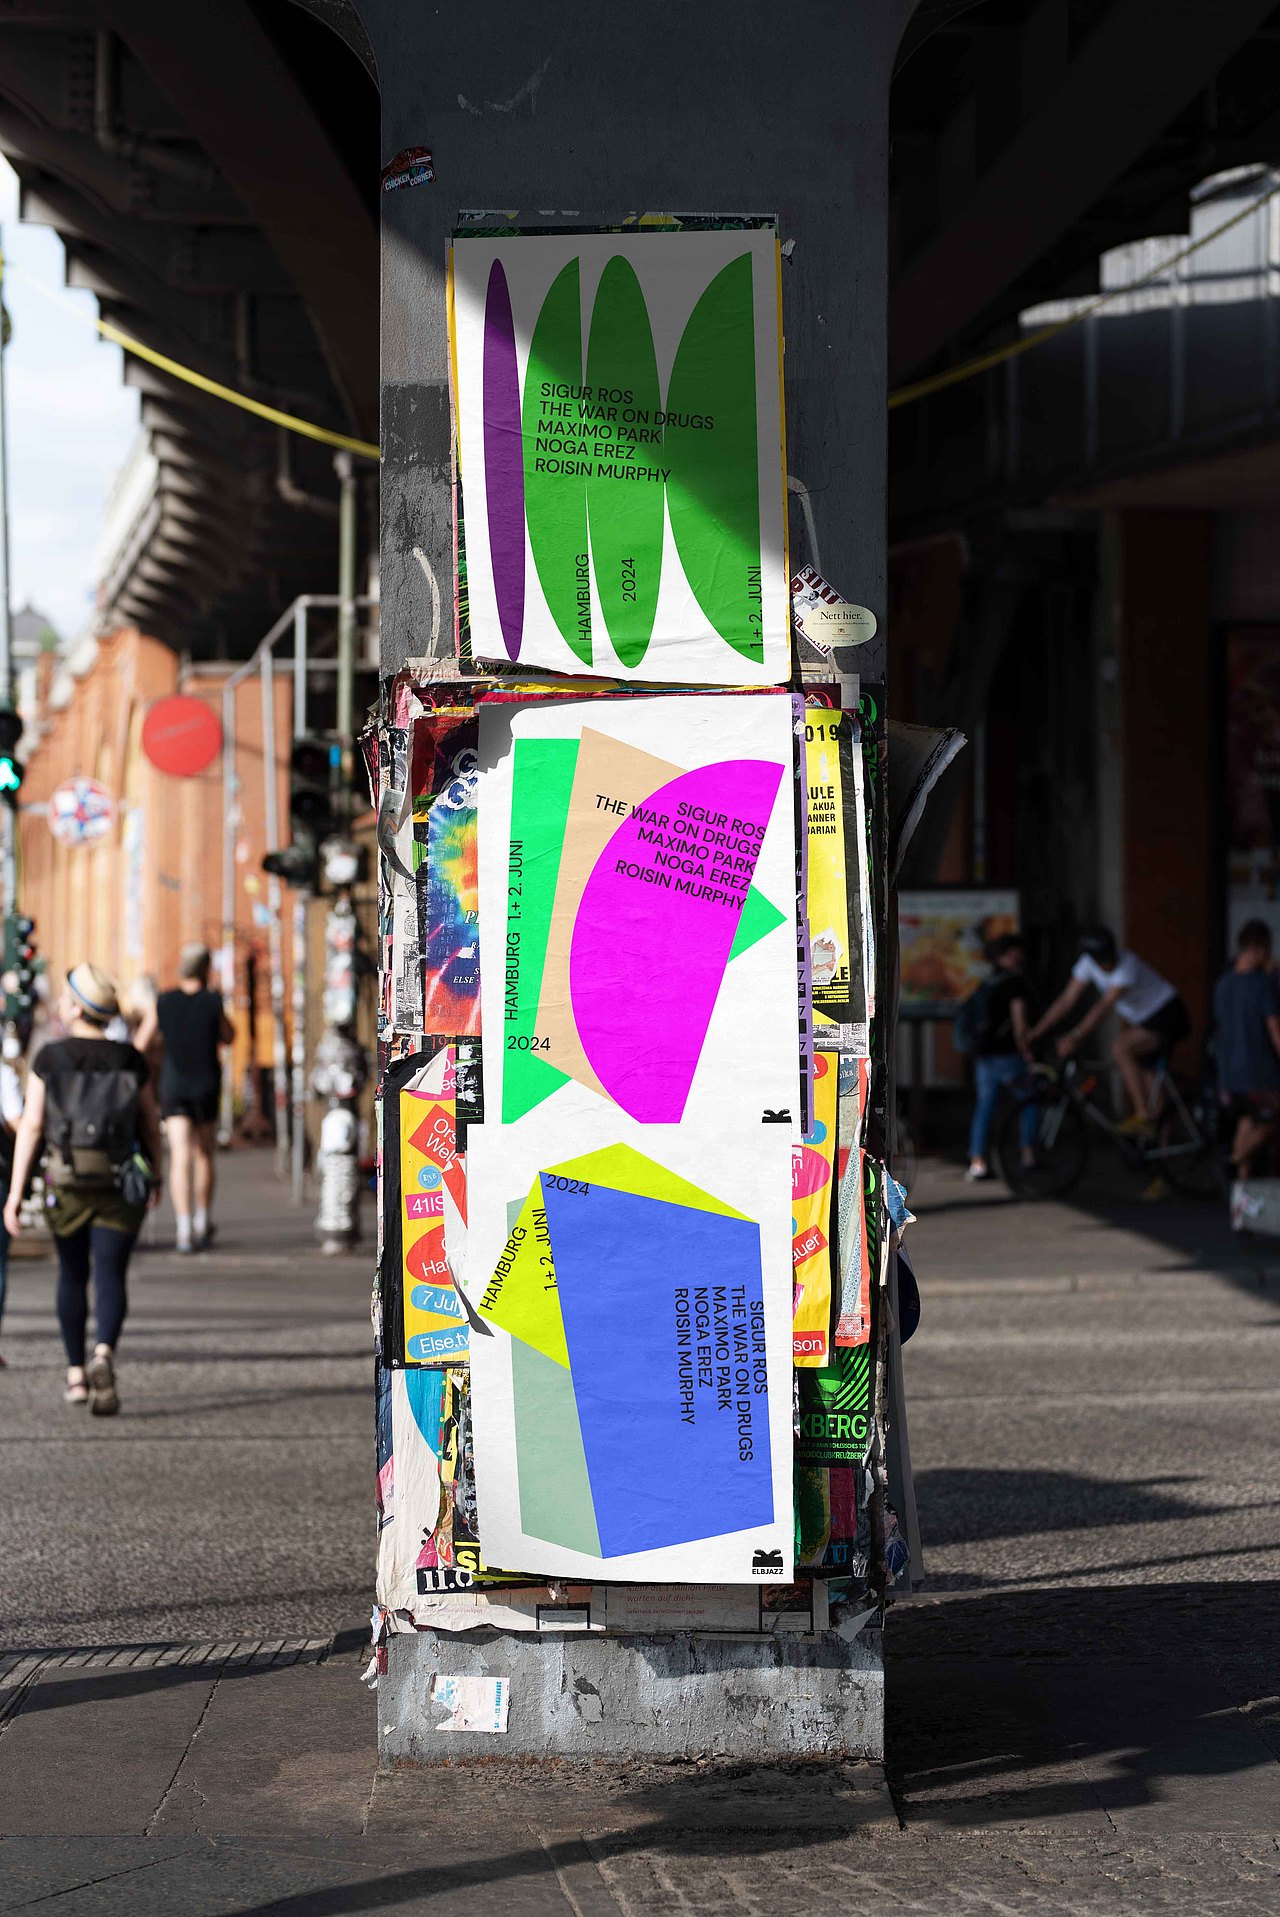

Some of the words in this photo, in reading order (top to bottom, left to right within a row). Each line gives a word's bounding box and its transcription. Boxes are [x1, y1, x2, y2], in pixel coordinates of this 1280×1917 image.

[385, 173, 410, 190] CHICKEN
[410, 170, 433, 186] CORNER
[541, 382, 593, 400] SIGUR
[598, 388, 634, 404] ROS
[538, 420, 612, 440] MAXIMO
[617, 426, 662, 444] PARK
[540, 400, 572, 417] THE
[578, 404, 617, 422] WAR
[622, 408, 650, 424] ON
[654, 412, 714, 430] DRUGS
[536, 438, 588, 456] NOGA
[594, 442, 636, 460] EREZ
[535, 458, 592, 476] ROISIN
[598, 464, 672, 482] MURPHY
[576, 554, 592, 641] HAMBURG
[622, 558, 636, 602] 2024
[748, 566, 762, 604] JUNI
[749, 609, 763, 623] 2.
[820, 611, 841, 620] Nett
[843, 611, 862, 620] hier.
[596, 794, 628, 816] THE
[632, 805, 670, 830] WAR
[674, 819, 700, 838] ON
[703, 828, 762, 856] DRUGS
[677, 802, 728, 828] SIGUR
[731, 818, 766, 840] ROS
[812, 802, 836, 811] AKUA
[509, 840, 523, 878] JUNI
[638, 827, 710, 860] MAXIMO
[713, 851, 757, 876] PARK
[508, 882, 522, 896] 2.
[615, 860, 672, 888] ROISIN
[674, 878, 747, 910] MURPHY
[654, 851, 705, 878] NOGA
[710, 868, 752, 892] EREZ
[454, 976, 474, 984] ELSE
[504, 932, 520, 1020] HAMBURG
[507, 1036, 550, 1051] 2024
[546, 1174, 590, 1196] 2024
[532, 1208, 550, 1246] JUNI
[480, 1226, 528, 1310] HAMBURG
[540, 1251, 554, 1266] 2.
[423, 1290, 434, 1306] 7
[674, 1288, 690, 1346] ROISIN
[694, 1288, 710, 1341] NOGA
[731, 1284, 746, 1318] THE
[712, 1286, 730, 1361] MAXIMO
[750, 1300, 766, 1353] SIGUR
[733, 1323, 748, 1364] WAR
[698, 1346, 712, 1388] EREZ
[736, 1368, 750, 1395] ON
[753, 1358, 768, 1394] ROS
[678, 1352, 695, 1425] MURPHY
[716, 1366, 732, 1411] PARK
[736, 1400, 754, 1462] DRUGS
[658, 1594, 672, 1604] auf
[673, 1594, 694, 1602] dich!
